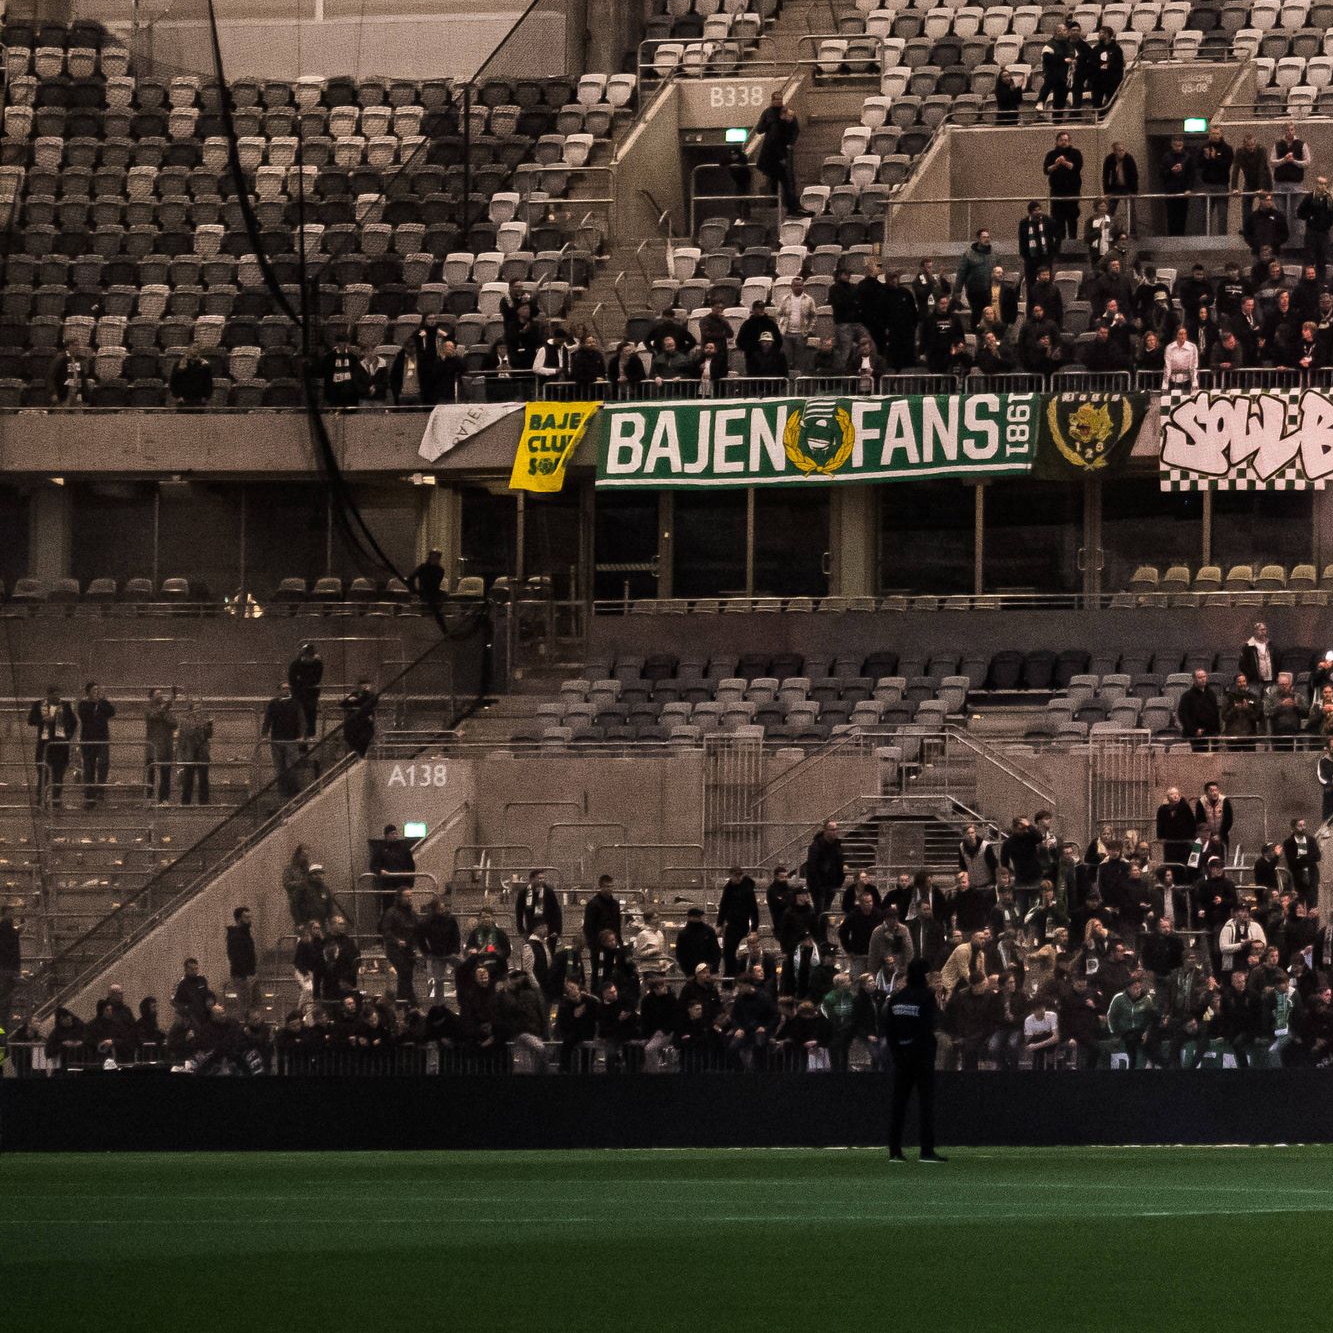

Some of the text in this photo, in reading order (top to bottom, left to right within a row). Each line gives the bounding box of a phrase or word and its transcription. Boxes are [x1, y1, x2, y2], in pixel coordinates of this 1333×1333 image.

[710, 87, 763, 106] B338
[529, 412, 586, 430] BAJE
[1005, 392, 1034, 458] 1981
[606, 393, 1000, 474] BAJEN FANS
[387, 764, 447, 787] A138
